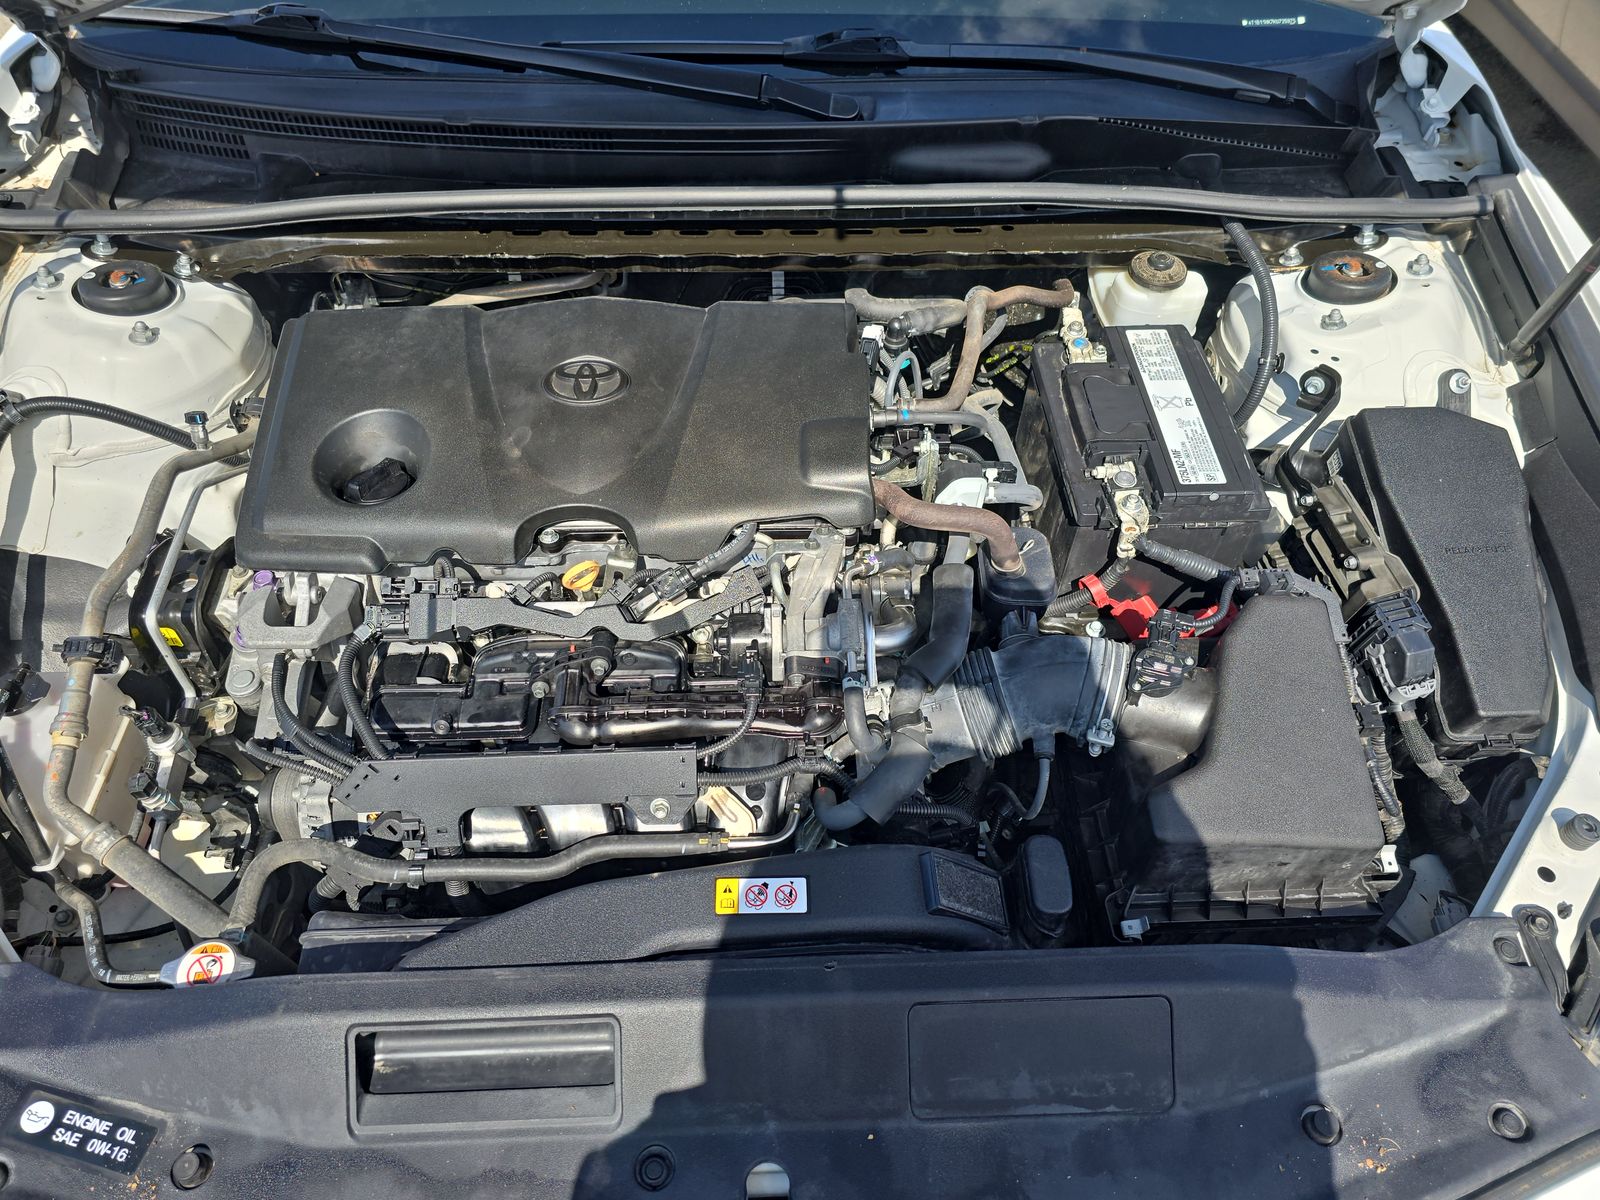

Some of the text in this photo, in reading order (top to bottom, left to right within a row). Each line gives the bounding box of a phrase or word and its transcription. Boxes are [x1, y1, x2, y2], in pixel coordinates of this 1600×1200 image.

[1172, 449, 1192, 483] 375LN2-MF
[62, 1110, 137, 1145] ENGINE OIL
[52, 1128, 129, 1162] SAE 0W-16
